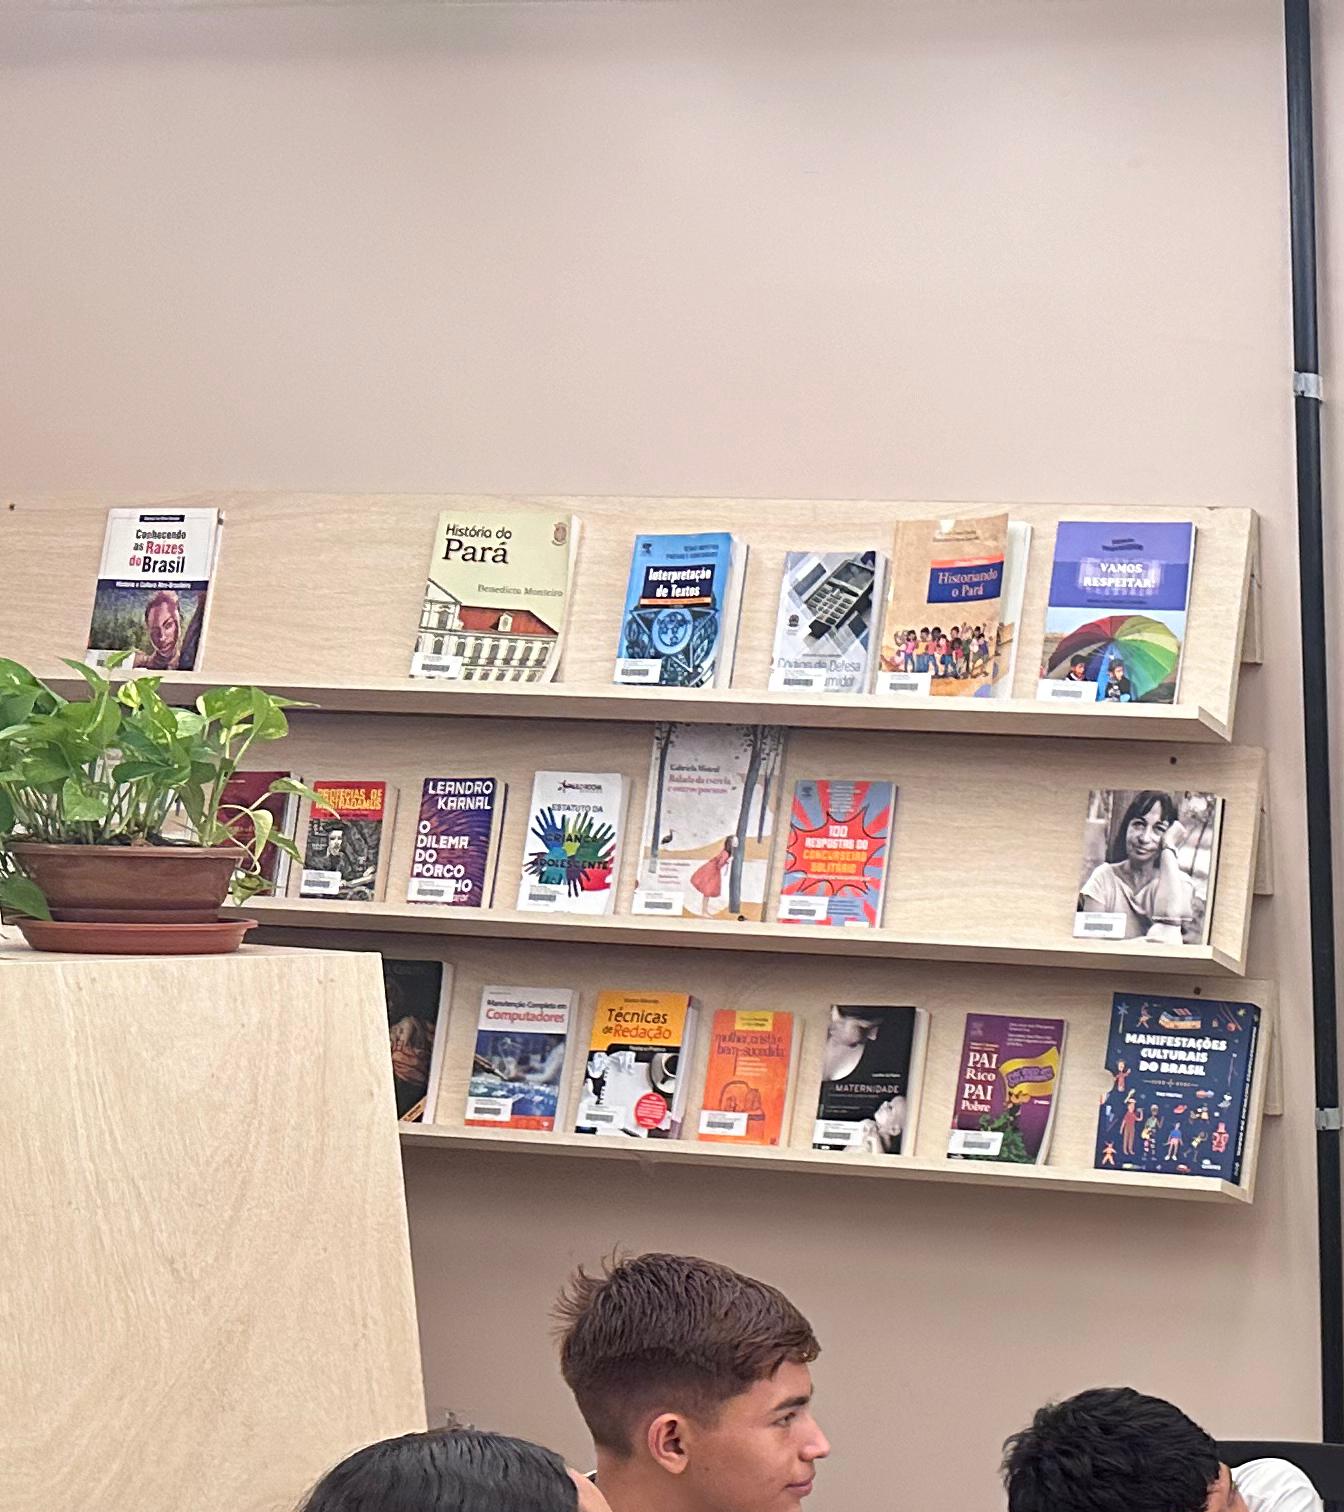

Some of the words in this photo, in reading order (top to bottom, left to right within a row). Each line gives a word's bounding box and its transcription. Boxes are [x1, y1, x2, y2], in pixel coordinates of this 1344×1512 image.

[135, 528, 187, 540] Conhecendo
[446, 523, 492, 539] História
[495, 526, 512, 540] do
[146, 540, 184, 555] Raízes
[442, 538, 509, 564] Pará
[129, 554, 141, 566] do
[141, 556, 186, 574] Brasil
[1100, 563, 1143, 573] VAMOS
[648, 566, 712, 583] Interpretação
[938, 569, 998, 585] Historiando
[655, 584, 669, 597] de
[671, 584, 700, 597] Textos
[961, 583, 984, 597] Pará
[829, 659, 861, 673] Defesa
[428, 780, 493, 794] LEANDRO
[437, 796, 492, 810] KARNAL
[552, 803, 591, 812] ESTATUTO
[592, 804, 603, 812] DA
[419, 820, 431, 834] O
[829, 825, 848, 837] 100
[417, 835, 469, 849] DILEMA
[415, 849, 437, 863] DO
[413, 863, 465, 878] PORCO
[486, 1008, 565, 1024] Computadores
[607, 1006, 669, 1025] Técnicas
[602, 1025, 614, 1035] de
[613, 1023, 672, 1041] Redação
[1125, 1033, 1228, 1051] MANIFESTAÇÕES
[967, 1052, 998, 1069] PAI
[1140, 1048, 1209, 1063] CULTURAIS
[965, 1068, 996, 1082] Rico
[1139, 1061, 1158, 1073] DO
[1160, 1062, 1206, 1076] BRASIL
[835, 1084, 900, 1095] MATERNIDADE
[963, 1083, 993, 1100] PAI
[961, 1099, 991, 1112] Pobre
